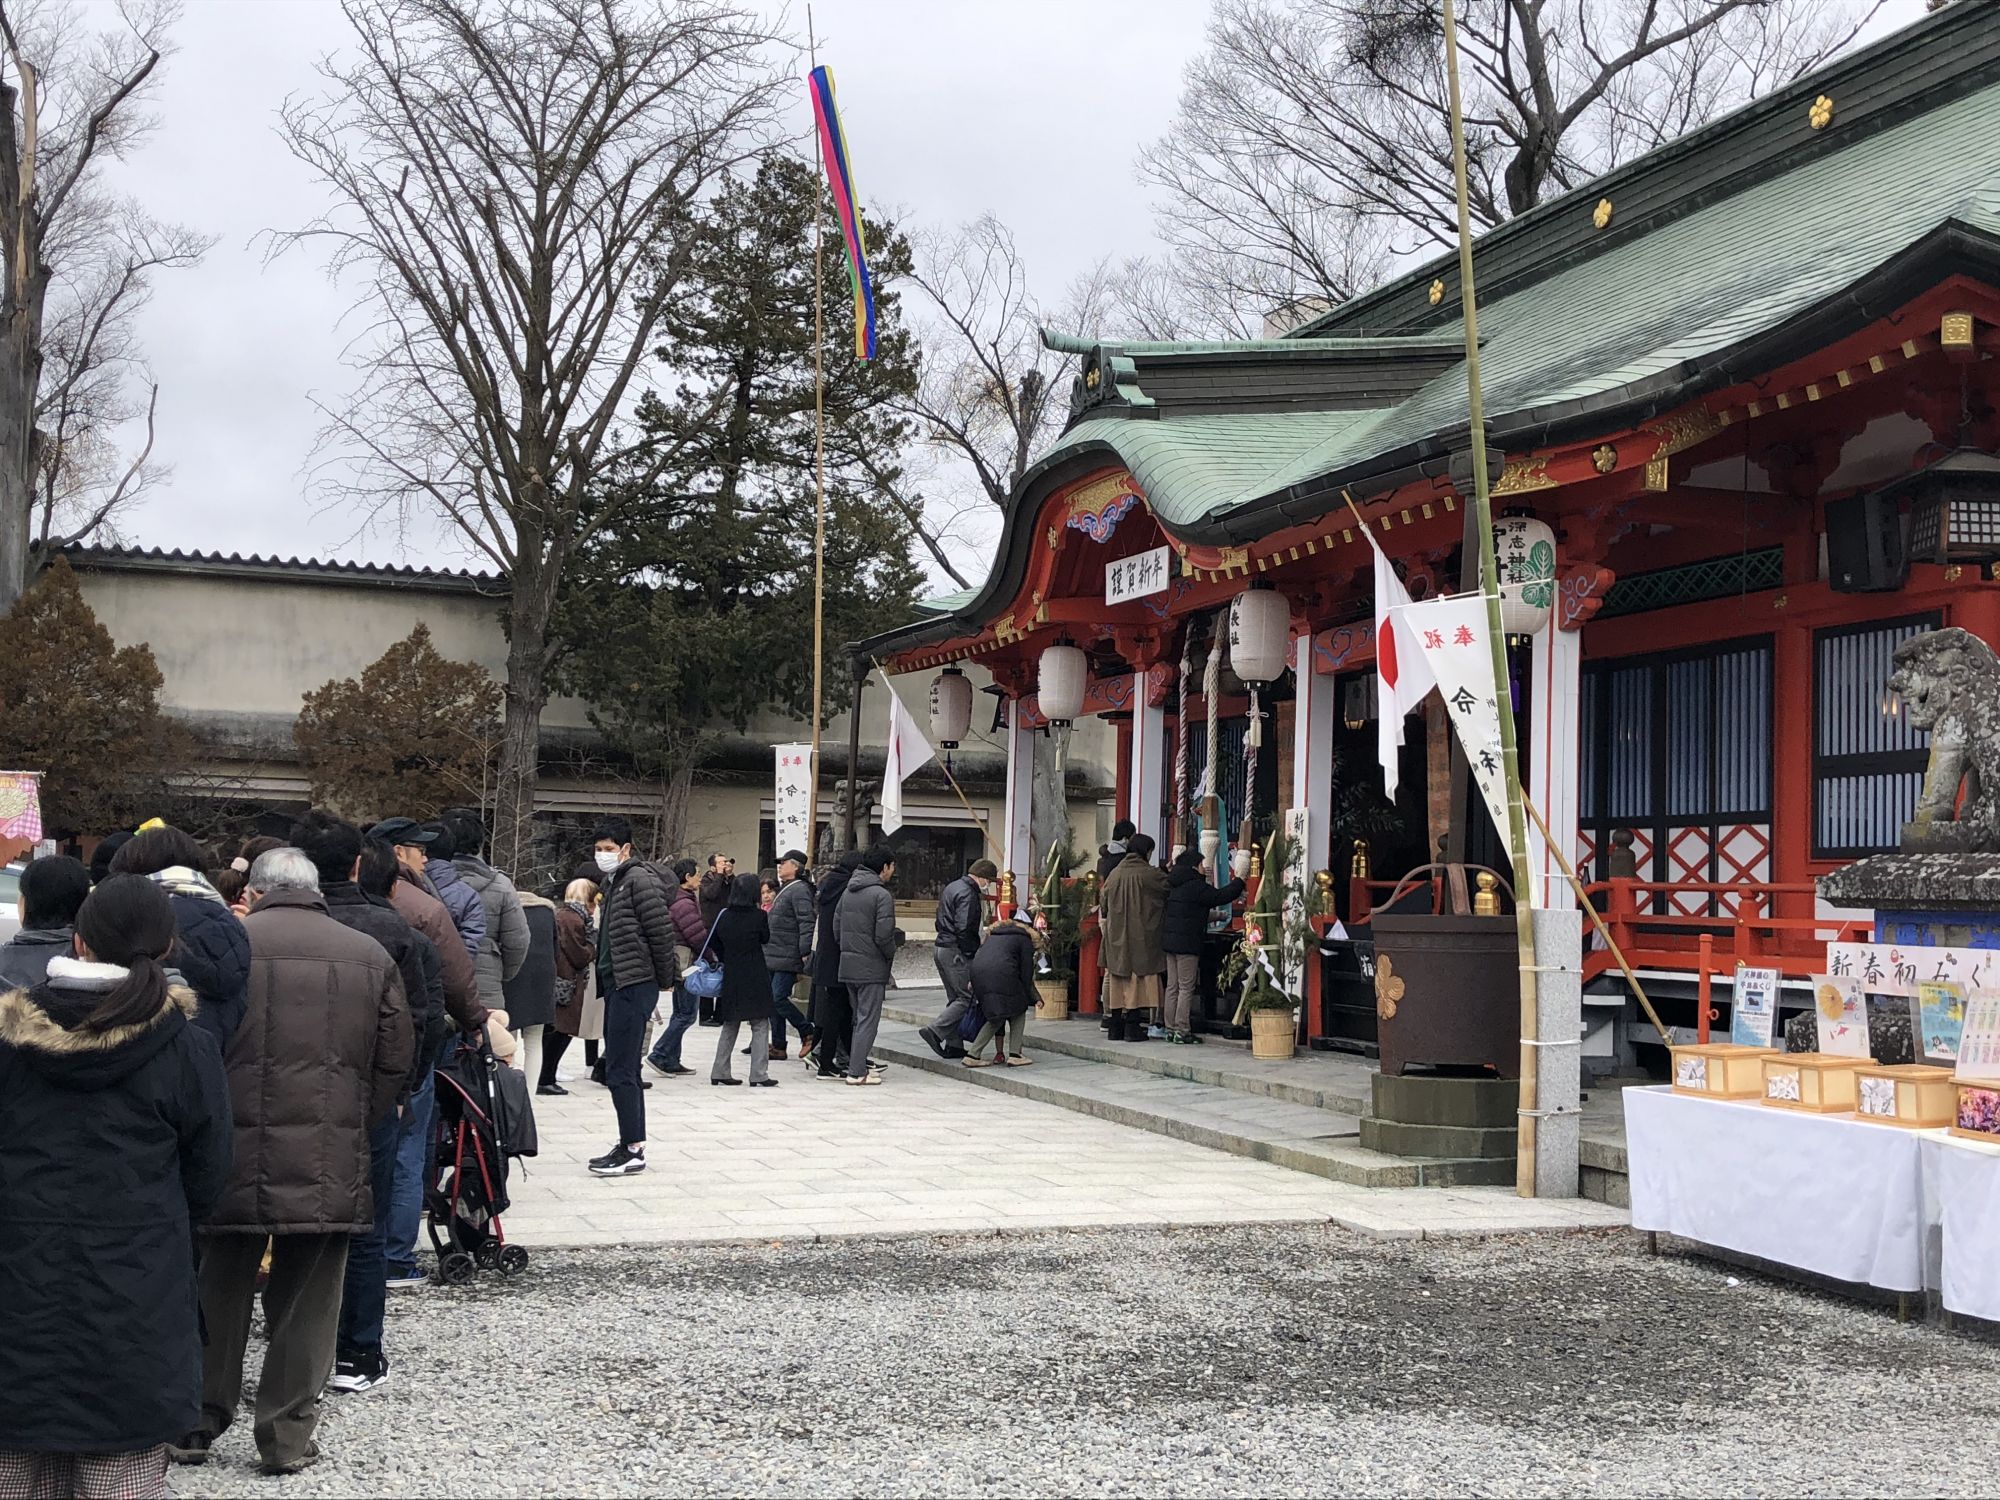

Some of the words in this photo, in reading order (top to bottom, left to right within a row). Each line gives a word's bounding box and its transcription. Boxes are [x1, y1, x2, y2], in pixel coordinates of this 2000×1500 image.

[1111, 551, 1162, 596] 謹賀新年
[1507, 521, 1527, 584] 深志神社
